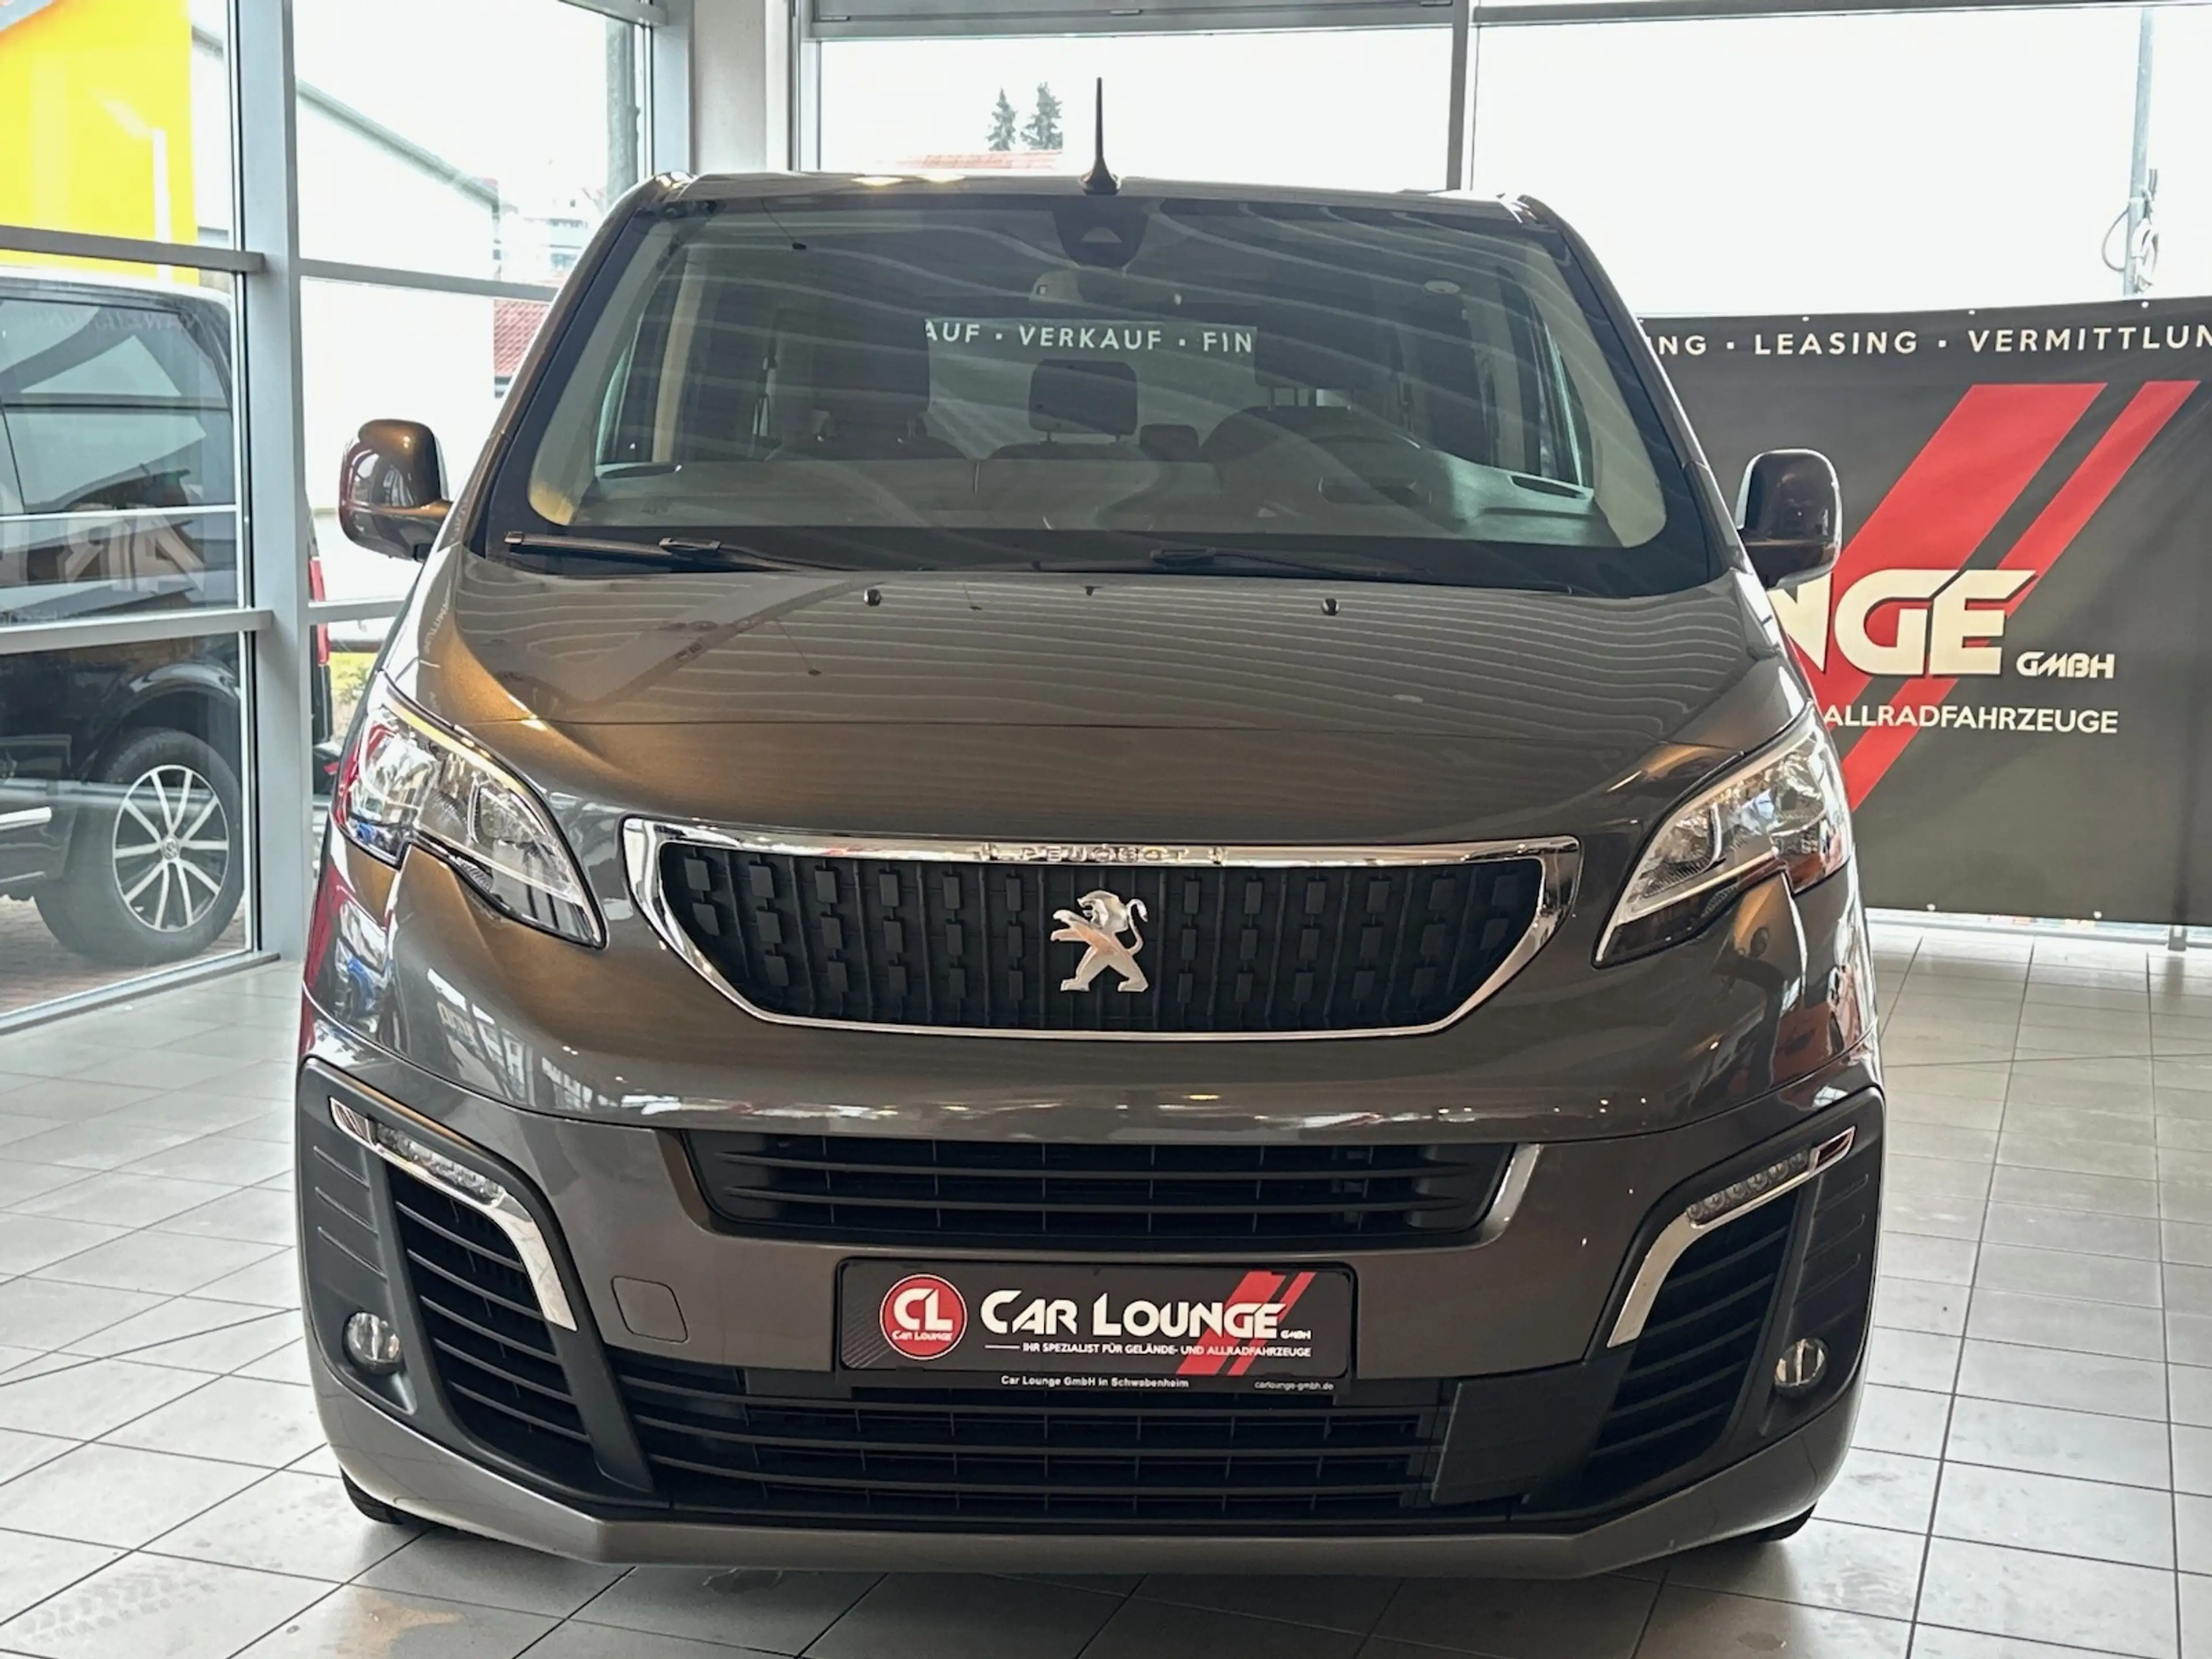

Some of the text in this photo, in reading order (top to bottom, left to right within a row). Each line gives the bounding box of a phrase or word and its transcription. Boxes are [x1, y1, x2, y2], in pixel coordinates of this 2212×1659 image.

[1019, 325, 1161, 350] VERKAUF
[1203, 332, 1252, 353] FIN
[1755, 331, 1918, 355] LEASING
[1824, 705, 2119, 734] ALLRADFAHRZEUGE
[893, 1288, 953, 1331] CL
[1022, 1342, 1312, 1357] IHR SPEZIALIST FÜR GELÄNDE- UND ALLRADFAHRZEUGE
[1001, 1376, 1190, 1388] Car Lounge GmbH in Schwabenheim
